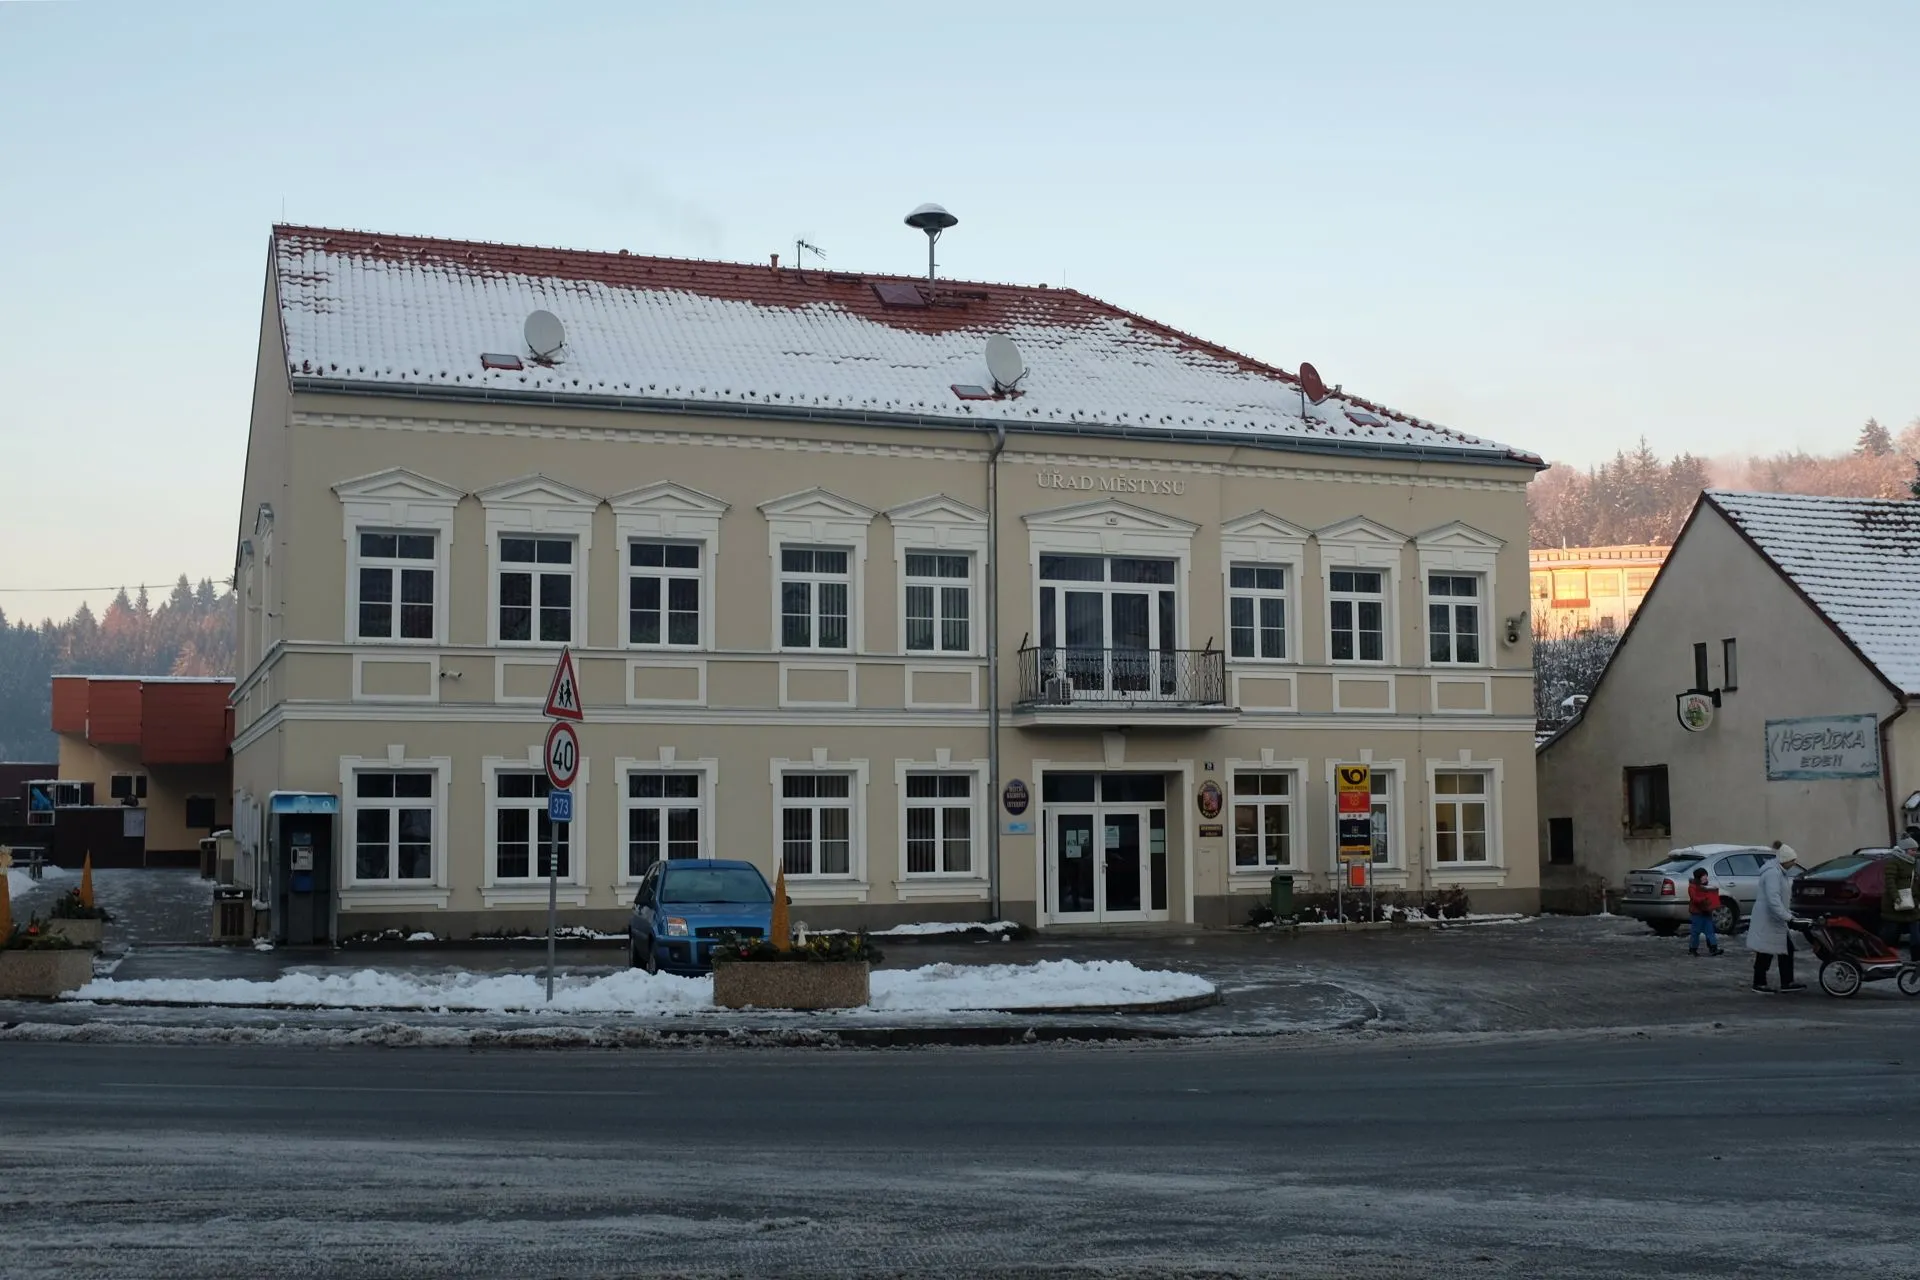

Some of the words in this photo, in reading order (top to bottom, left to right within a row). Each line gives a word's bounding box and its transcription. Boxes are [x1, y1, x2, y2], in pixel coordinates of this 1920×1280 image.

[1037, 468, 1094, 490] ÚŘAD
[553, 739, 574, 772] 40
[553, 798, 569, 815] 373
